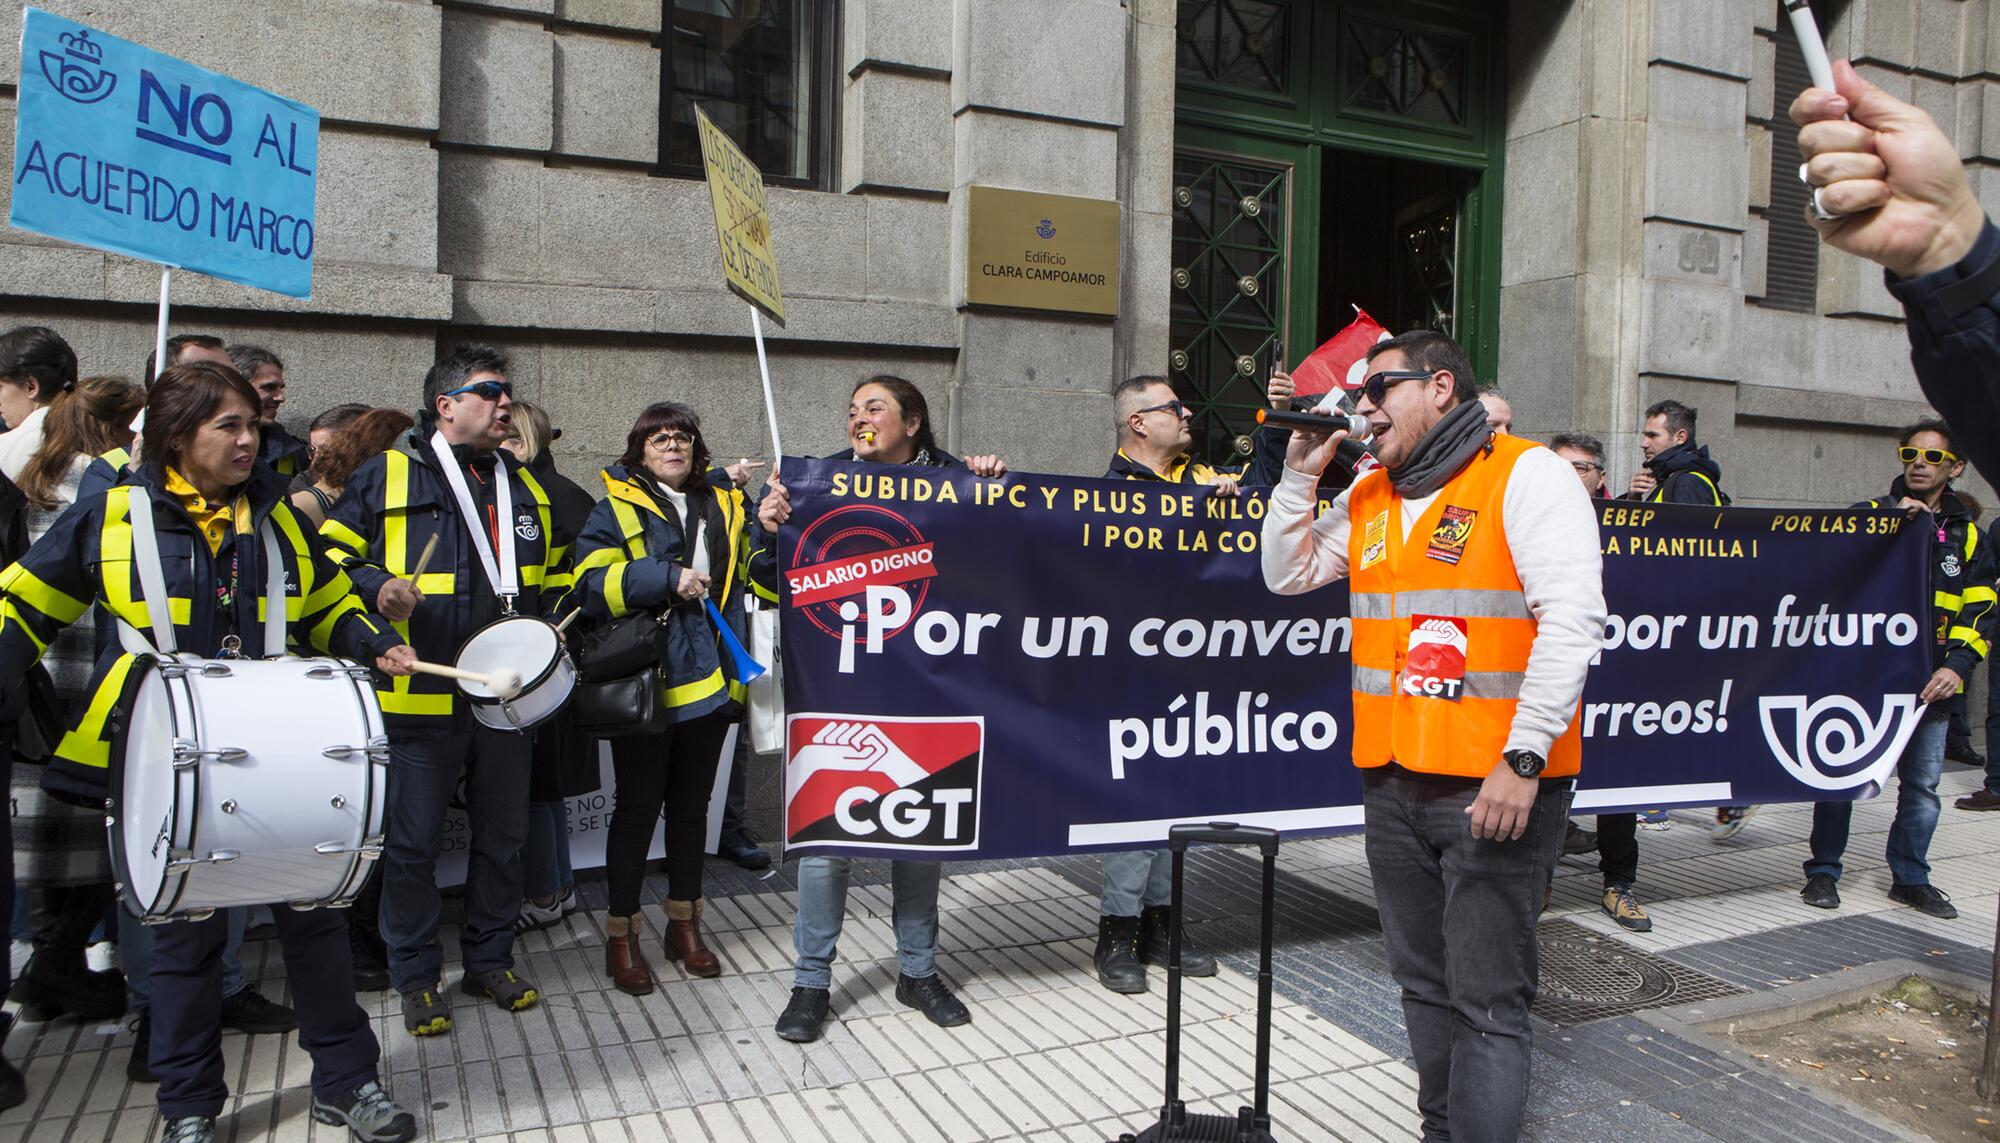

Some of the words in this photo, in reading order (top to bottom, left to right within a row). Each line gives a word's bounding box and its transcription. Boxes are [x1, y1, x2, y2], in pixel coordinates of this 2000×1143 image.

[137, 69, 233, 146] NO
[254, 113, 312, 176] AL
[17, 140, 199, 231] ACUERDO
[210, 192, 313, 260] MARCO
[983, 264, 1023, 278] CLARA
[1026, 267, 1105, 285] CAMPOAMOR
[1025, 250, 1066, 265] Edificio
[831, 473, 958, 503] SUBIDA
[975, 482, 1026, 508] IPC
[1041, 487, 1059, 509] Y
[1074, 489, 1146, 515] PLUS
[1161, 495, 1193, 517] DE
[1602, 507, 1655, 527] EBEP
[1770, 515, 1812, 532] POR
[1820, 515, 1857, 533] LAS
[1866, 516, 1900, 534] 35H
[1104, 526, 1164, 550] POR
[1178, 529, 1208, 553] LA
[1630, 537, 1744, 558] PLANTILLA
[790, 562, 867, 595] SALARIO
[871, 548, 933, 575] DIGNO
[839, 585, 1001, 673] ¡Por
[1021, 616, 1109, 658] un
[1129, 616, 1351, 658] conven
[1699, 615, 1758, 649] un
[1771, 594, 1918, 647] futuro
[1404, 675, 1461, 697] CGT
[1109, 691, 1338, 779] público
[1583, 679, 1733, 737] rreos!
[578, 795, 605, 813] NO
[579, 815, 600, 832] SE
[834, 786, 972, 838] CGT
